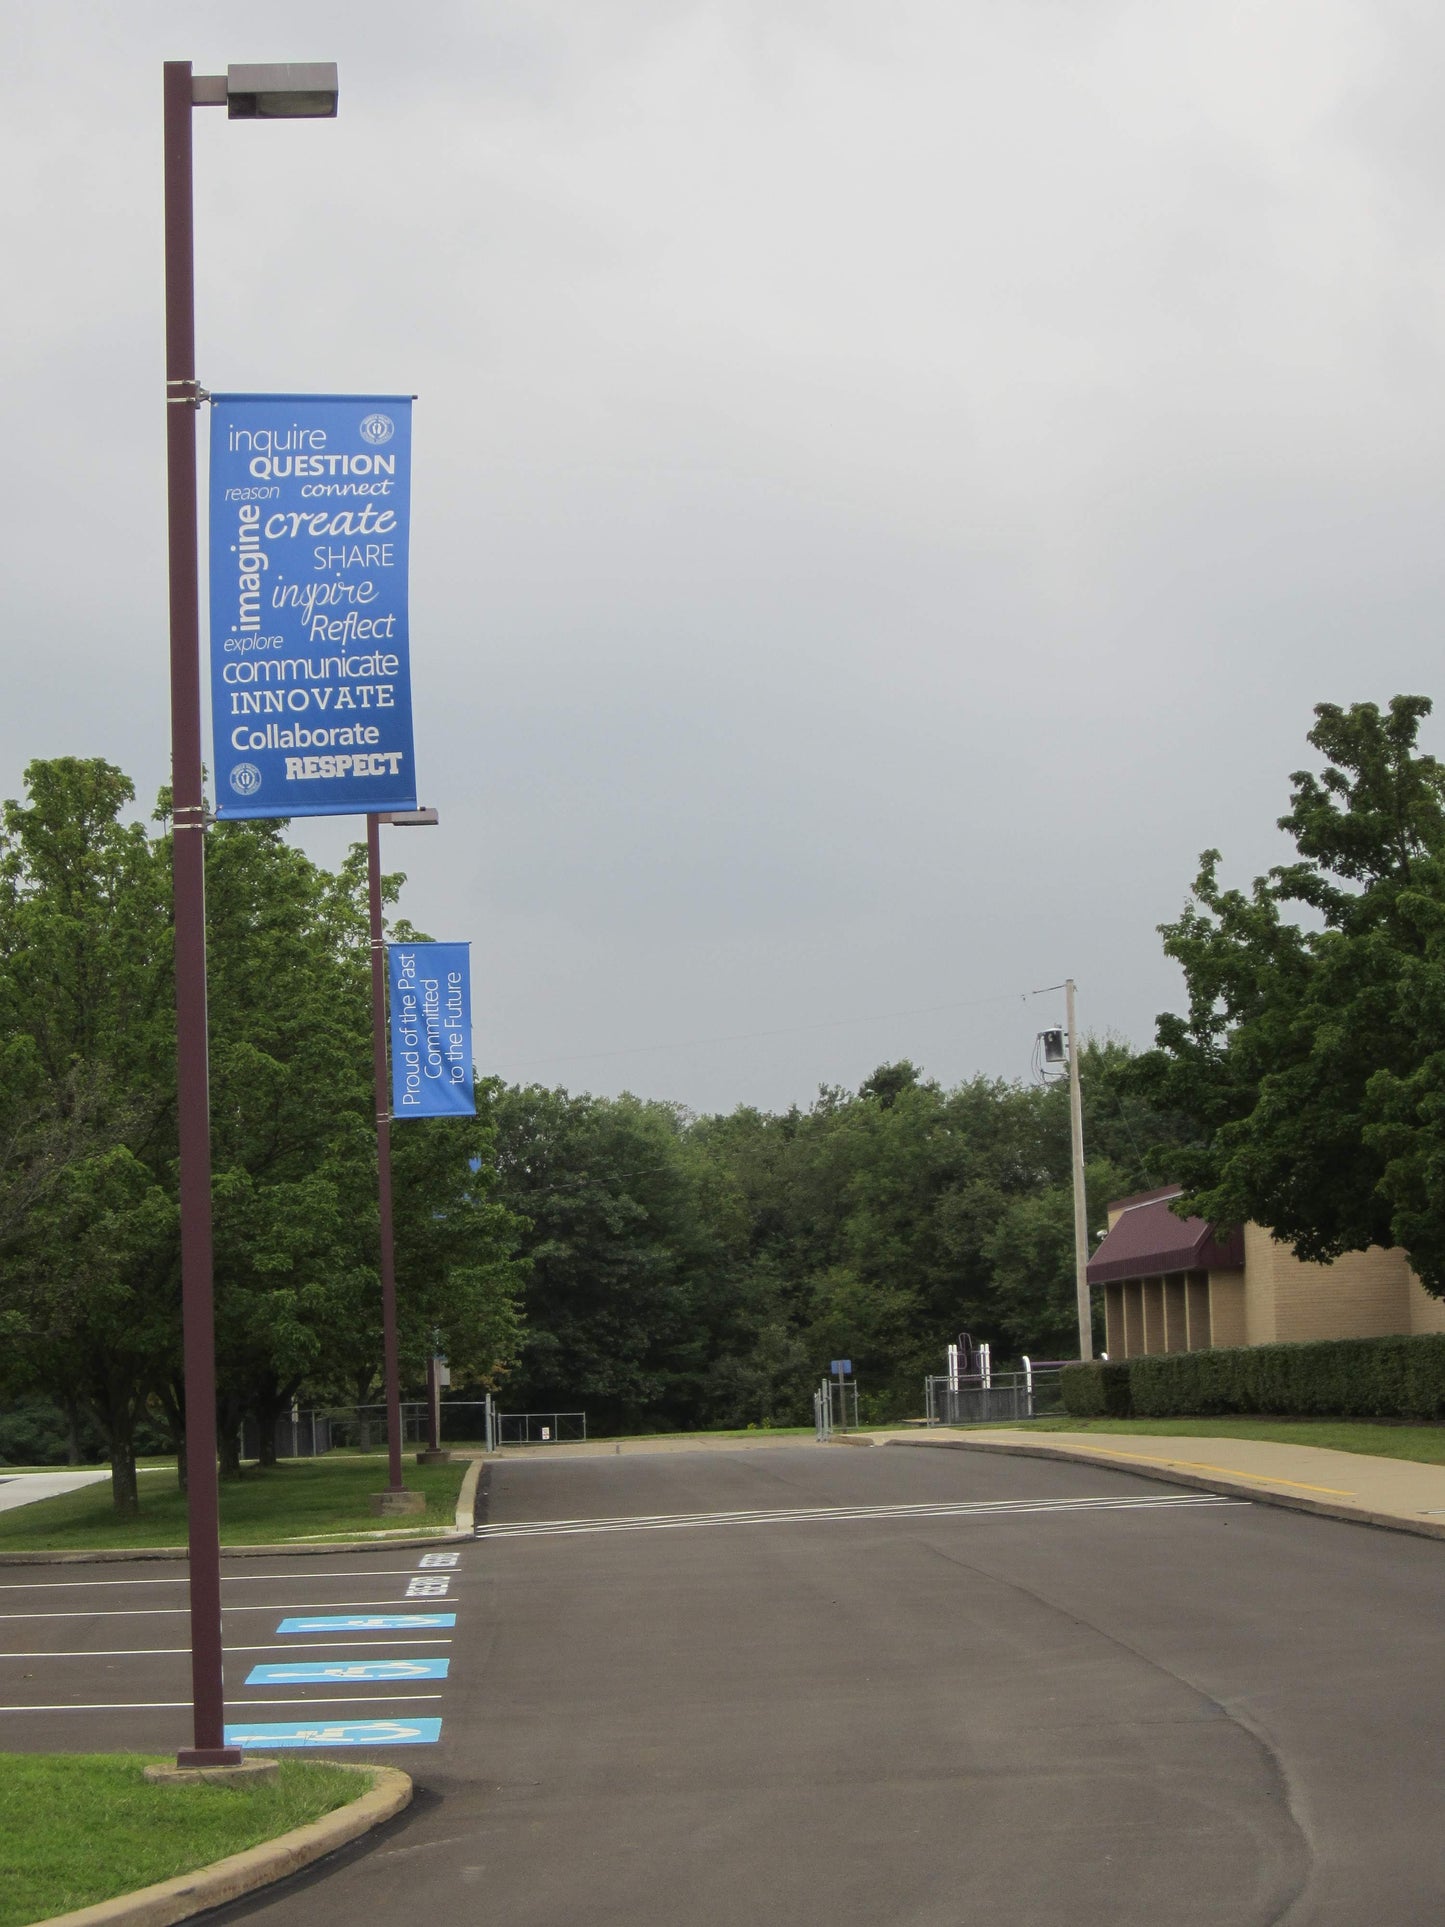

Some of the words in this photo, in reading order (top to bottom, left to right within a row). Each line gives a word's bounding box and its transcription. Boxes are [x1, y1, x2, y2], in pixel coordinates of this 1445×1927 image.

[229, 423, 327, 458] inquire
[249, 454, 395, 480] QUESTION
[225, 486, 280, 501] reason
[301, 479, 395, 498] connect
[264, 503, 397, 539] create
[230, 504, 269, 632] imagine
[314, 543, 395, 570] SHARE
[272, 572, 379, 626] inspire
[309, 611, 396, 646] Reflect
[224, 633, 284, 655] explore
[223, 649, 399, 684] communicate
[231, 685, 395, 715] INNOVATE
[231, 723, 380, 750] Collaborate
[285, 752, 403, 780] RESPECT
[397, 953, 416, 989] Past
[399, 995, 418, 1023] the
[444, 972, 463, 1028] Future
[399, 1028, 418, 1047] of
[419, 979, 443, 1079] Committed
[444, 1033, 465, 1063] the
[400, 1052, 421, 1105] Proud
[449, 1065, 465, 1085] to
